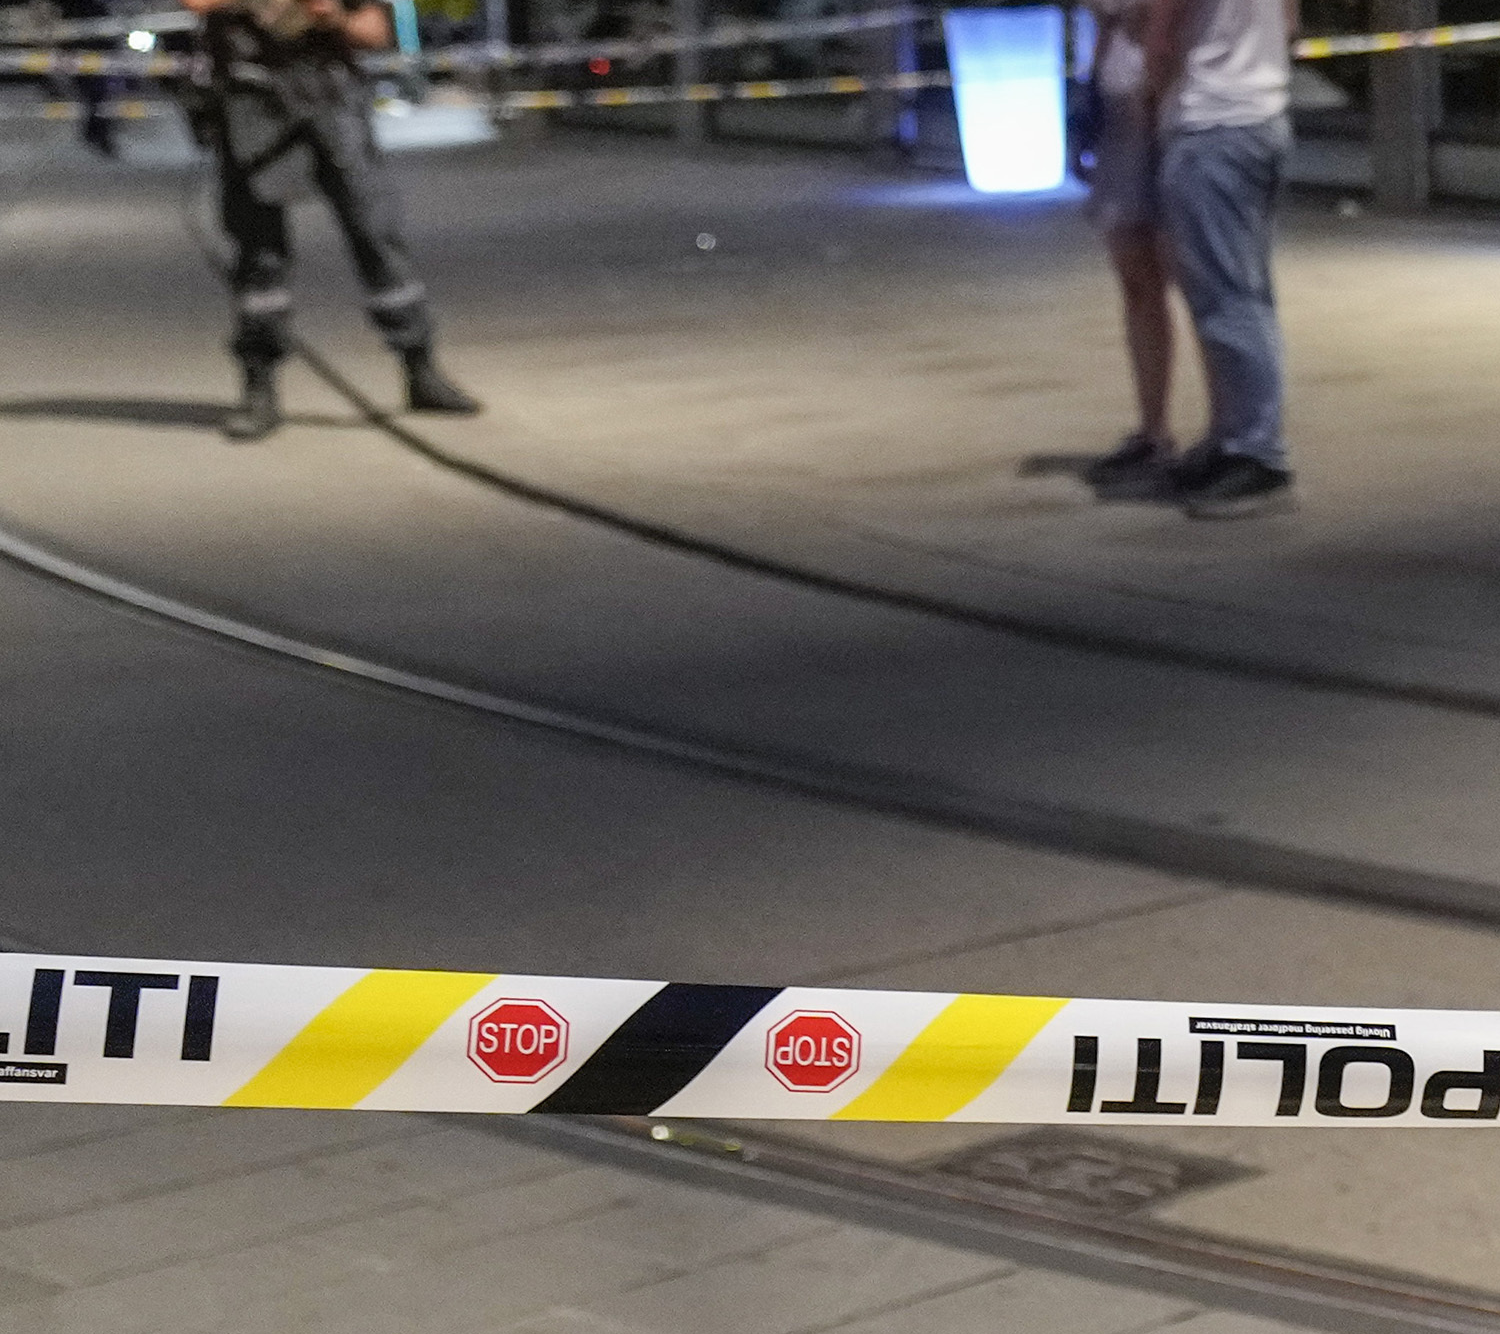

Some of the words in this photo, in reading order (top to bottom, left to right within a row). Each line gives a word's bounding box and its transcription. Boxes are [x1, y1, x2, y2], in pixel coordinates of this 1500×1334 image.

[0, 968, 220, 1062] ITI
[478, 1022, 560, 1056] STOP
[775, 1034, 852, 1068] STOP
